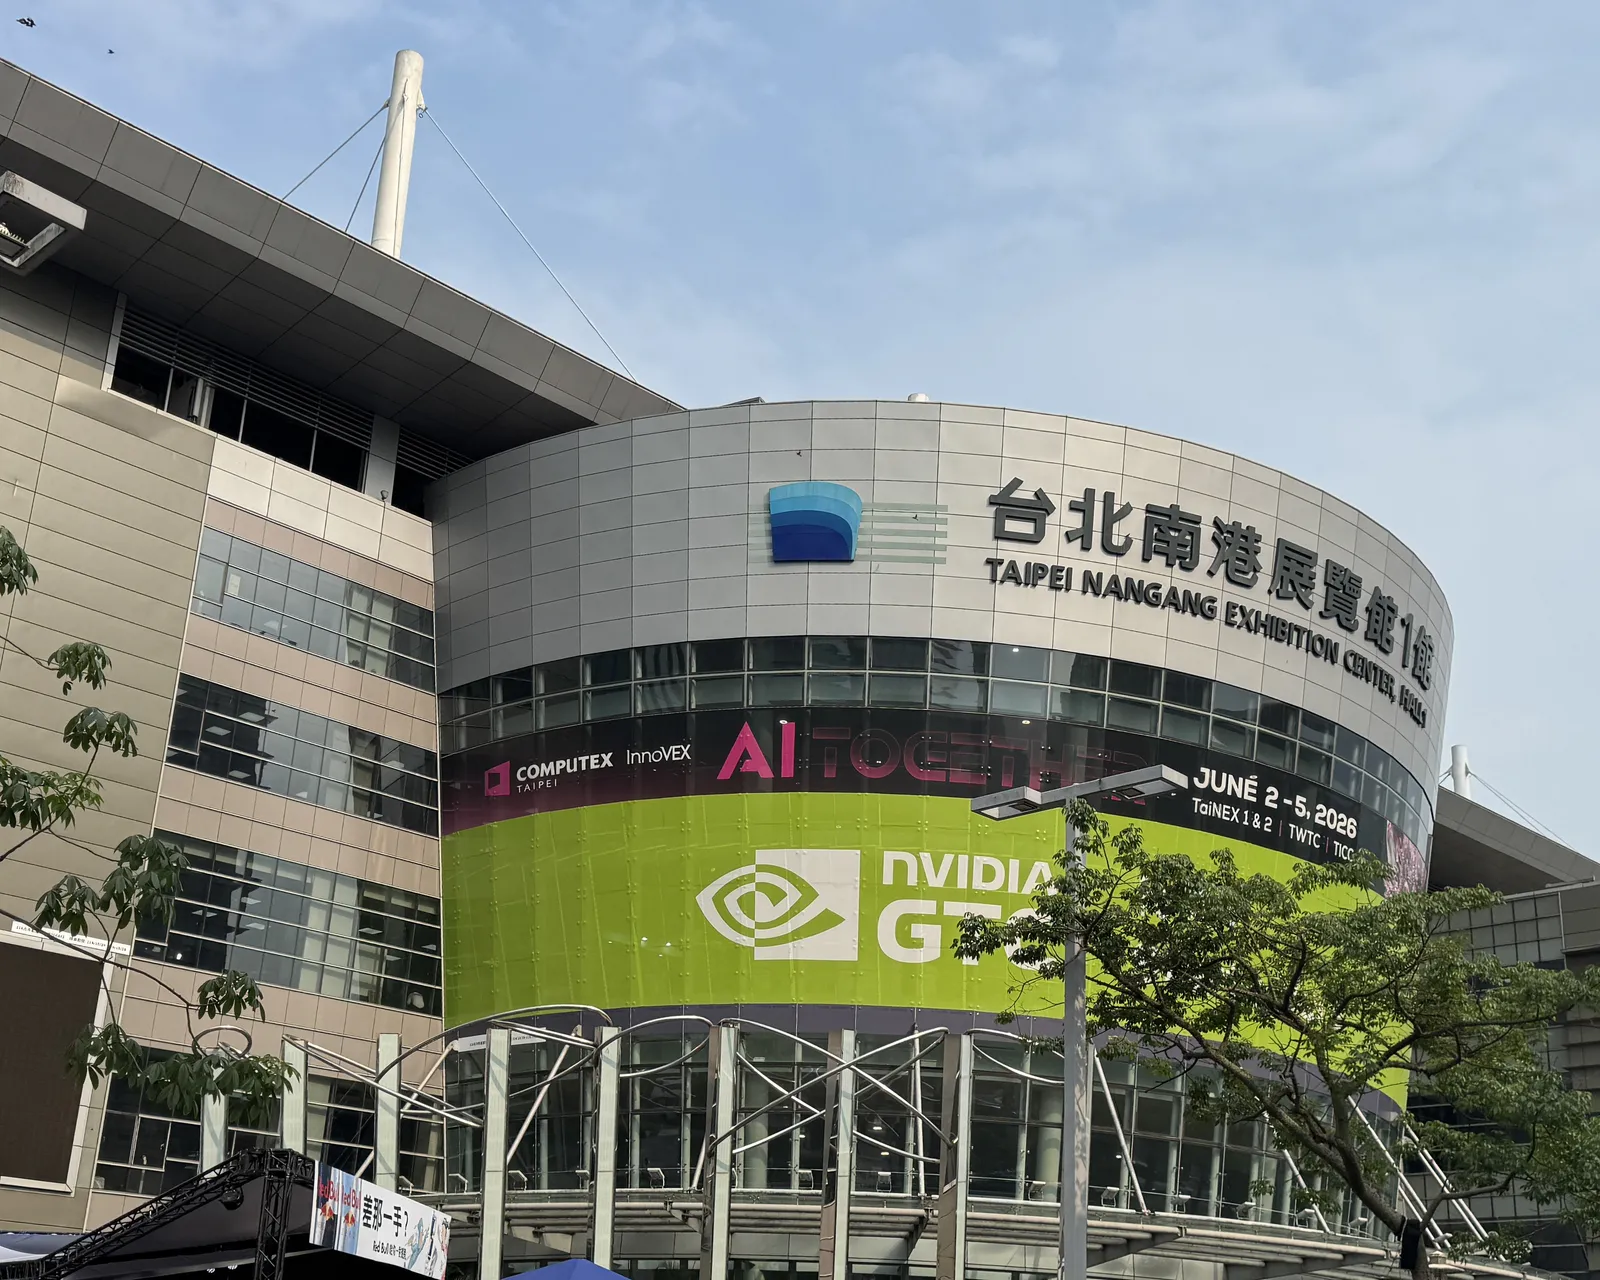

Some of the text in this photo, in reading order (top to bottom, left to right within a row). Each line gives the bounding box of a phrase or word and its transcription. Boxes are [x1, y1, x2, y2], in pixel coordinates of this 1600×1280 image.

[988, 476, 1434, 691] 台北南港展覽館1館
[985, 557, 1073, 591] TAIPEI
[1082, 569, 1218, 619] NANGANG
[1225, 602, 1340, 665] EXHIBITION
[1343, 649, 1397, 704] CENTER,
[516, 751, 614, 782] COMPUTEX
[626, 744, 692, 765] InnoVEX
[716, 720, 796, 780] AI
[516, 779, 558, 793] TAIPEI
[1193, 767, 1258, 802] JUNE
[1314, 804, 1358, 839] 2026
[1192, 797, 1273, 833] TaiNEX 1 & 2
[1288, 823, 1321, 849] TWTC
[362, 1194, 410, 1237] 差那一手?
